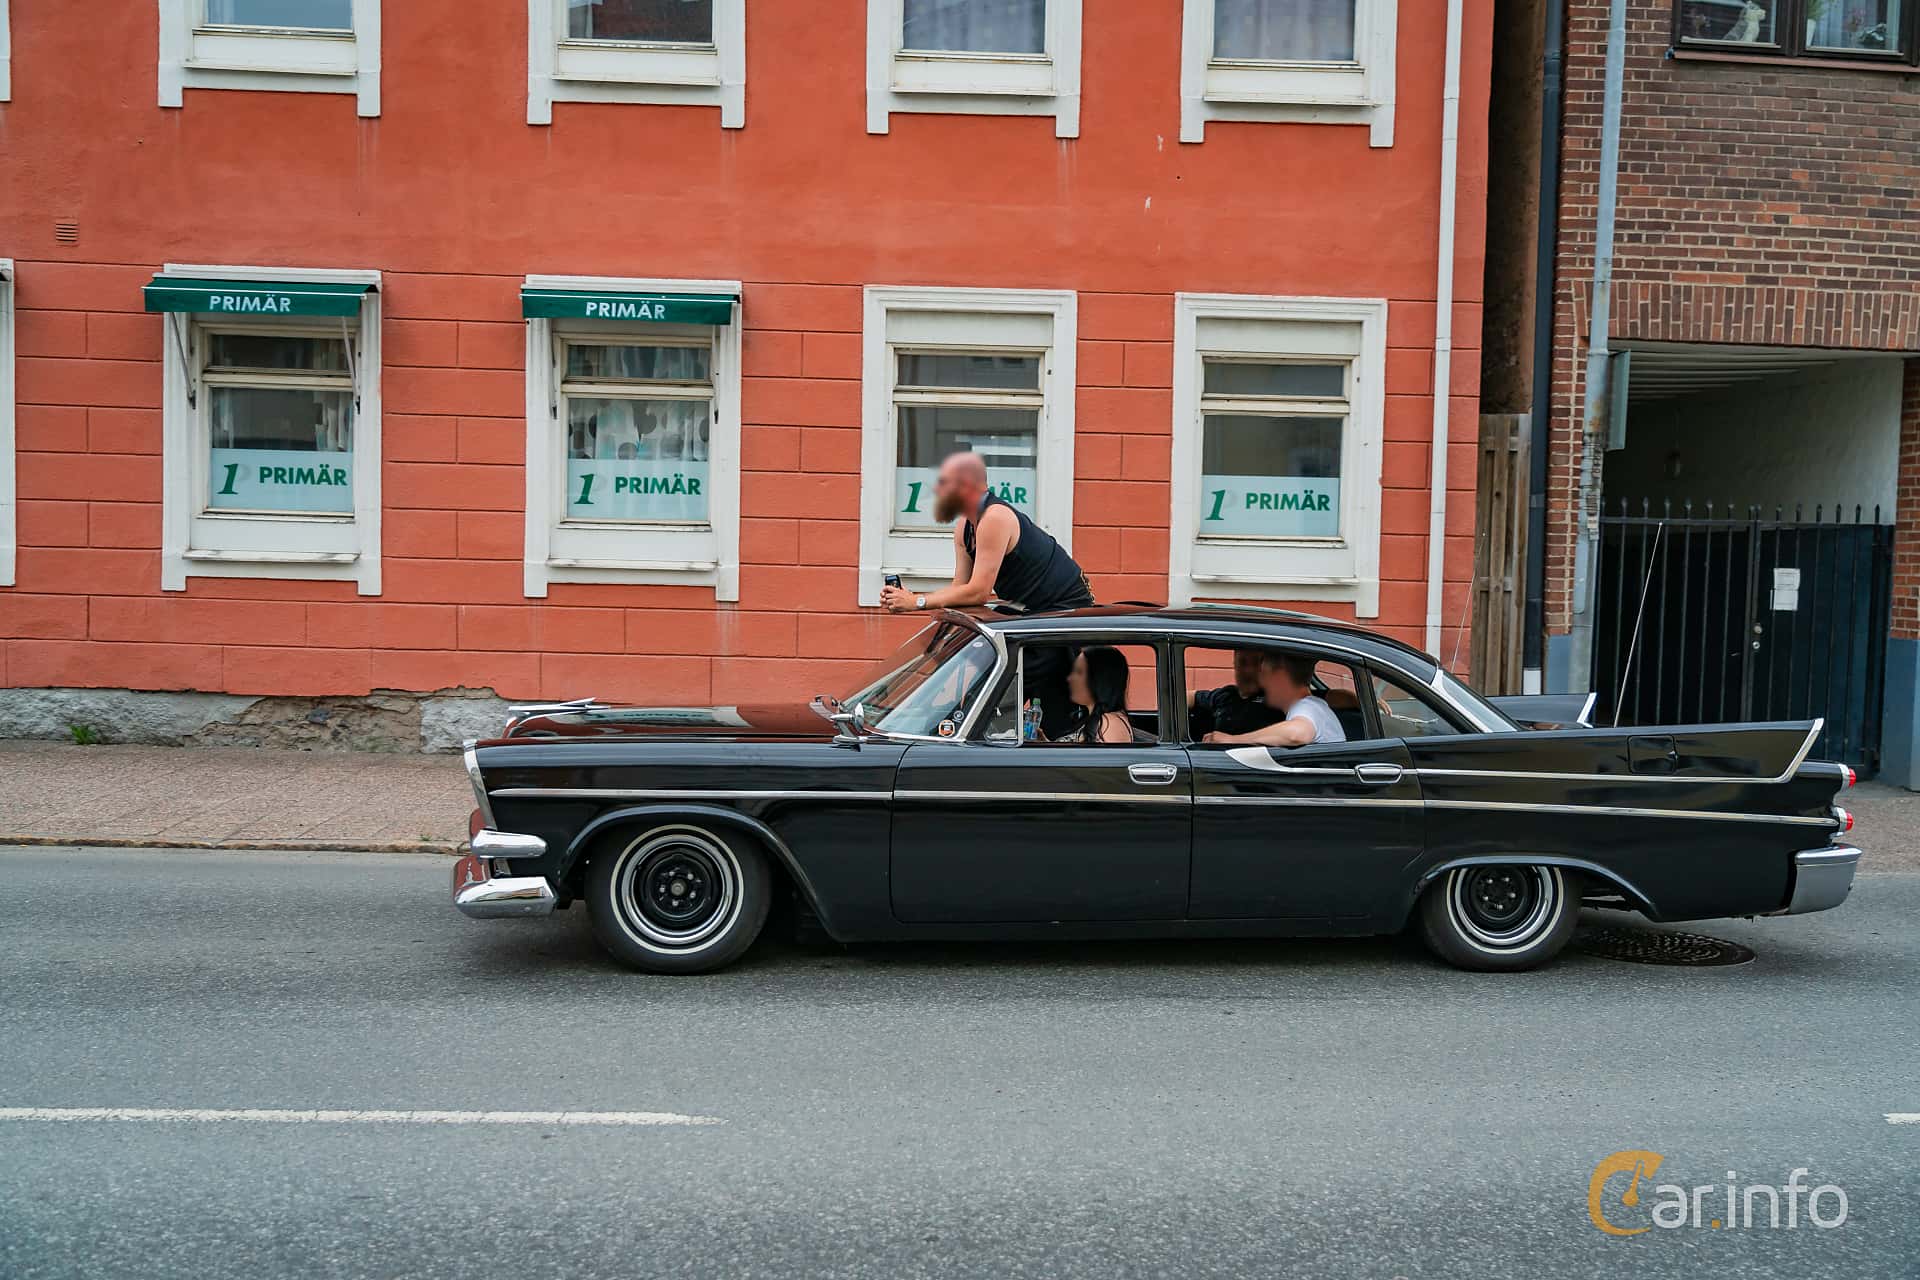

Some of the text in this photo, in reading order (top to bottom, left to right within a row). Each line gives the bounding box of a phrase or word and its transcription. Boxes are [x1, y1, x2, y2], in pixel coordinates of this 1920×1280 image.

[209, 294, 291, 312] PRIMÄR
[585, 300, 666, 319] PRIMÄR
[259, 464, 348, 486] PRIMÄR
[615, 473, 701, 495] PRIMÄR
[1246, 489, 1330, 511] PRIMÄR
